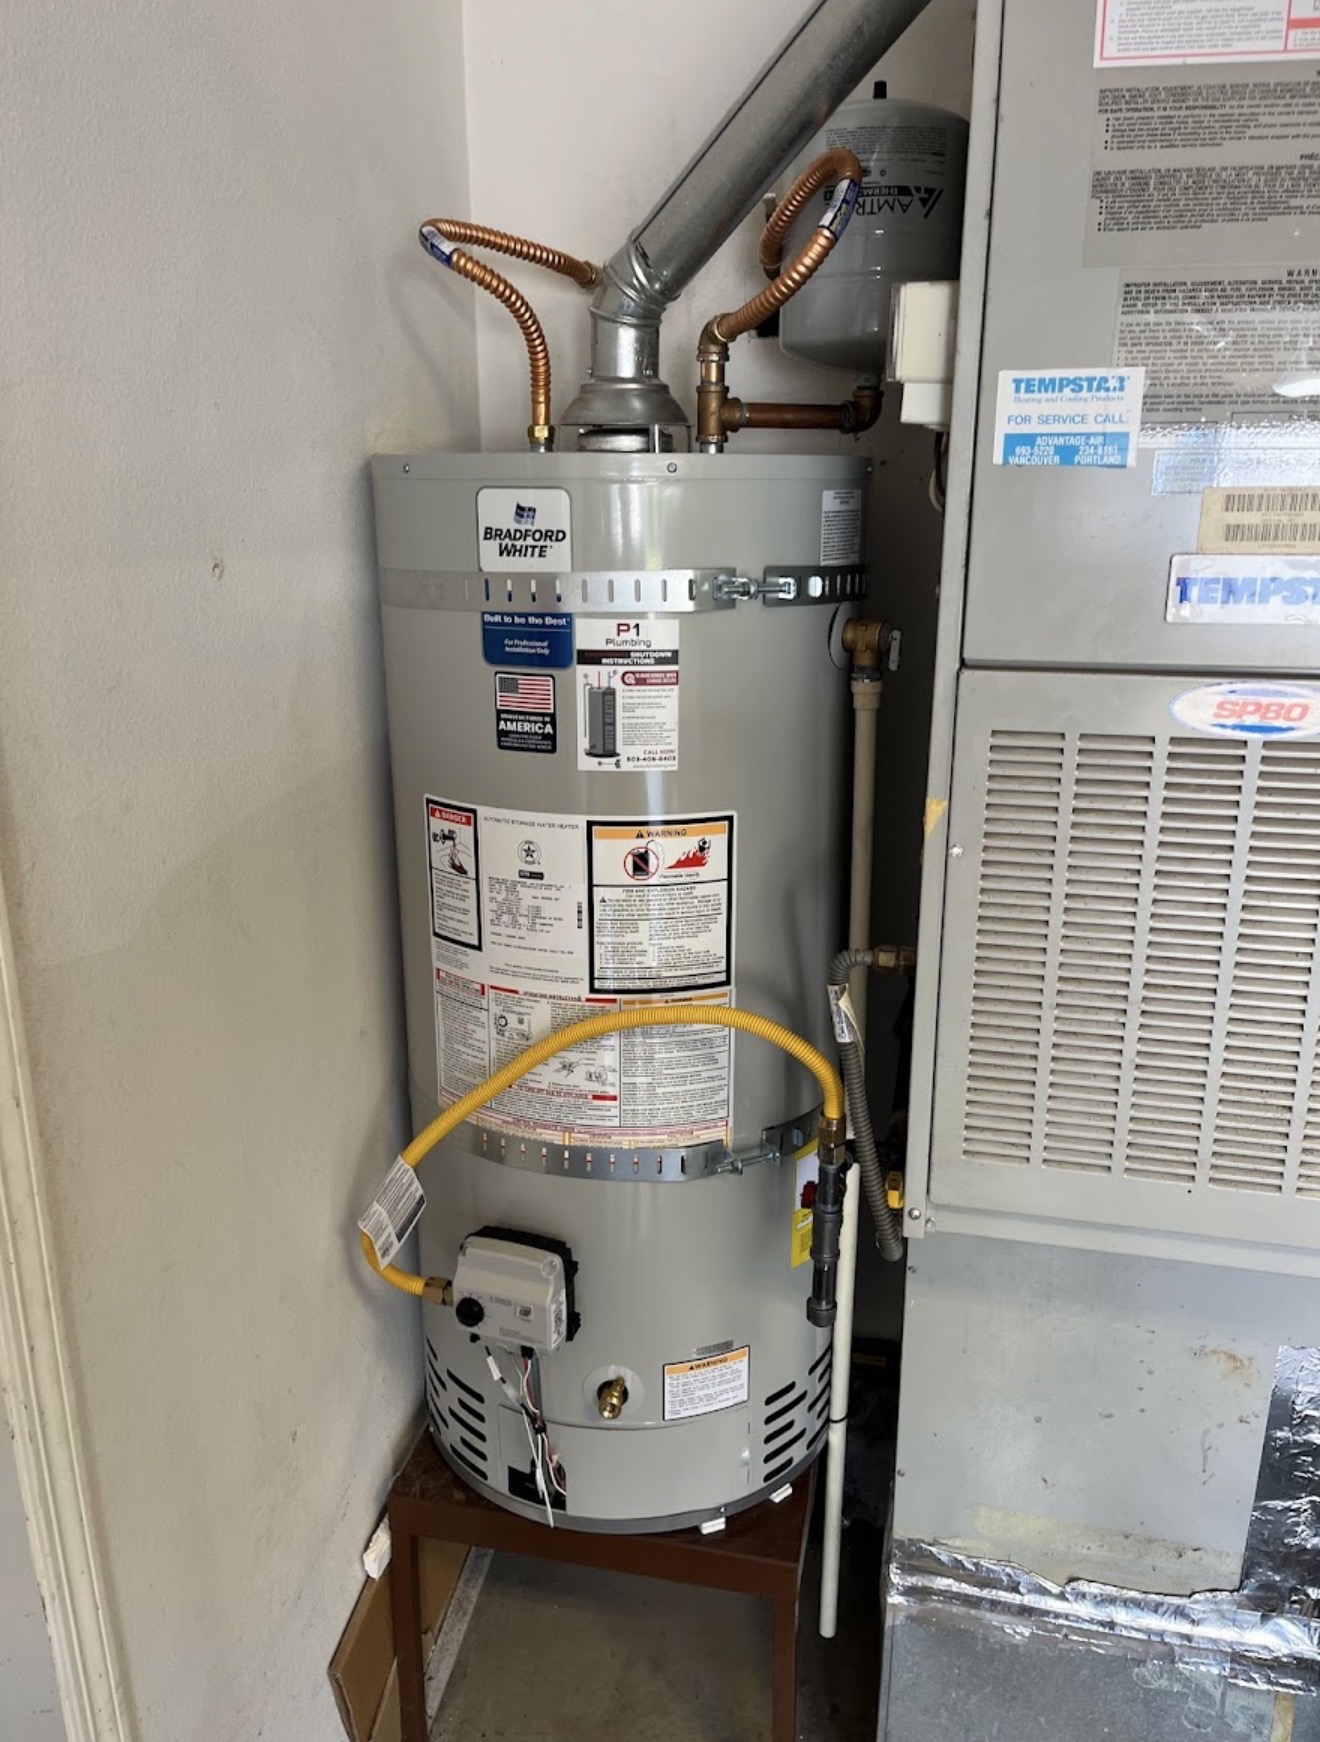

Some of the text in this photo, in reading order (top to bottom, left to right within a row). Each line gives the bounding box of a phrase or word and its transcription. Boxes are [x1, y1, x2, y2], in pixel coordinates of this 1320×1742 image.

[1012, 376, 1126, 394] TEMPSTAR
[1014, 395, 1041, 404] Heating
[1059, 395, 1088, 403] Cooling
[1007, 415, 1031, 425] FOR
[1037, 414, 1089, 425] SERVICE
[1035, 435, 1105, 446] ADVANTAGE-AIR
[1008, 455, 1121, 465] VANCOUVER PORTLAND
[483, 527, 567, 542] BRADFORD
[498, 542, 549, 558] WHITE
[484, 614, 502, 623] Built
[504, 615, 512, 623] to
[514, 615, 526, 625] be
[528, 616, 543, 625] the
[617, 623, 640, 637] P1
[605, 638, 652, 648] Plumbing
[1213, 700, 1311, 722] SP80
[499, 720, 554, 734] AMERICA
[646, 829, 687, 837] WARNING
[695, 1357, 728, 1369] WARNING
